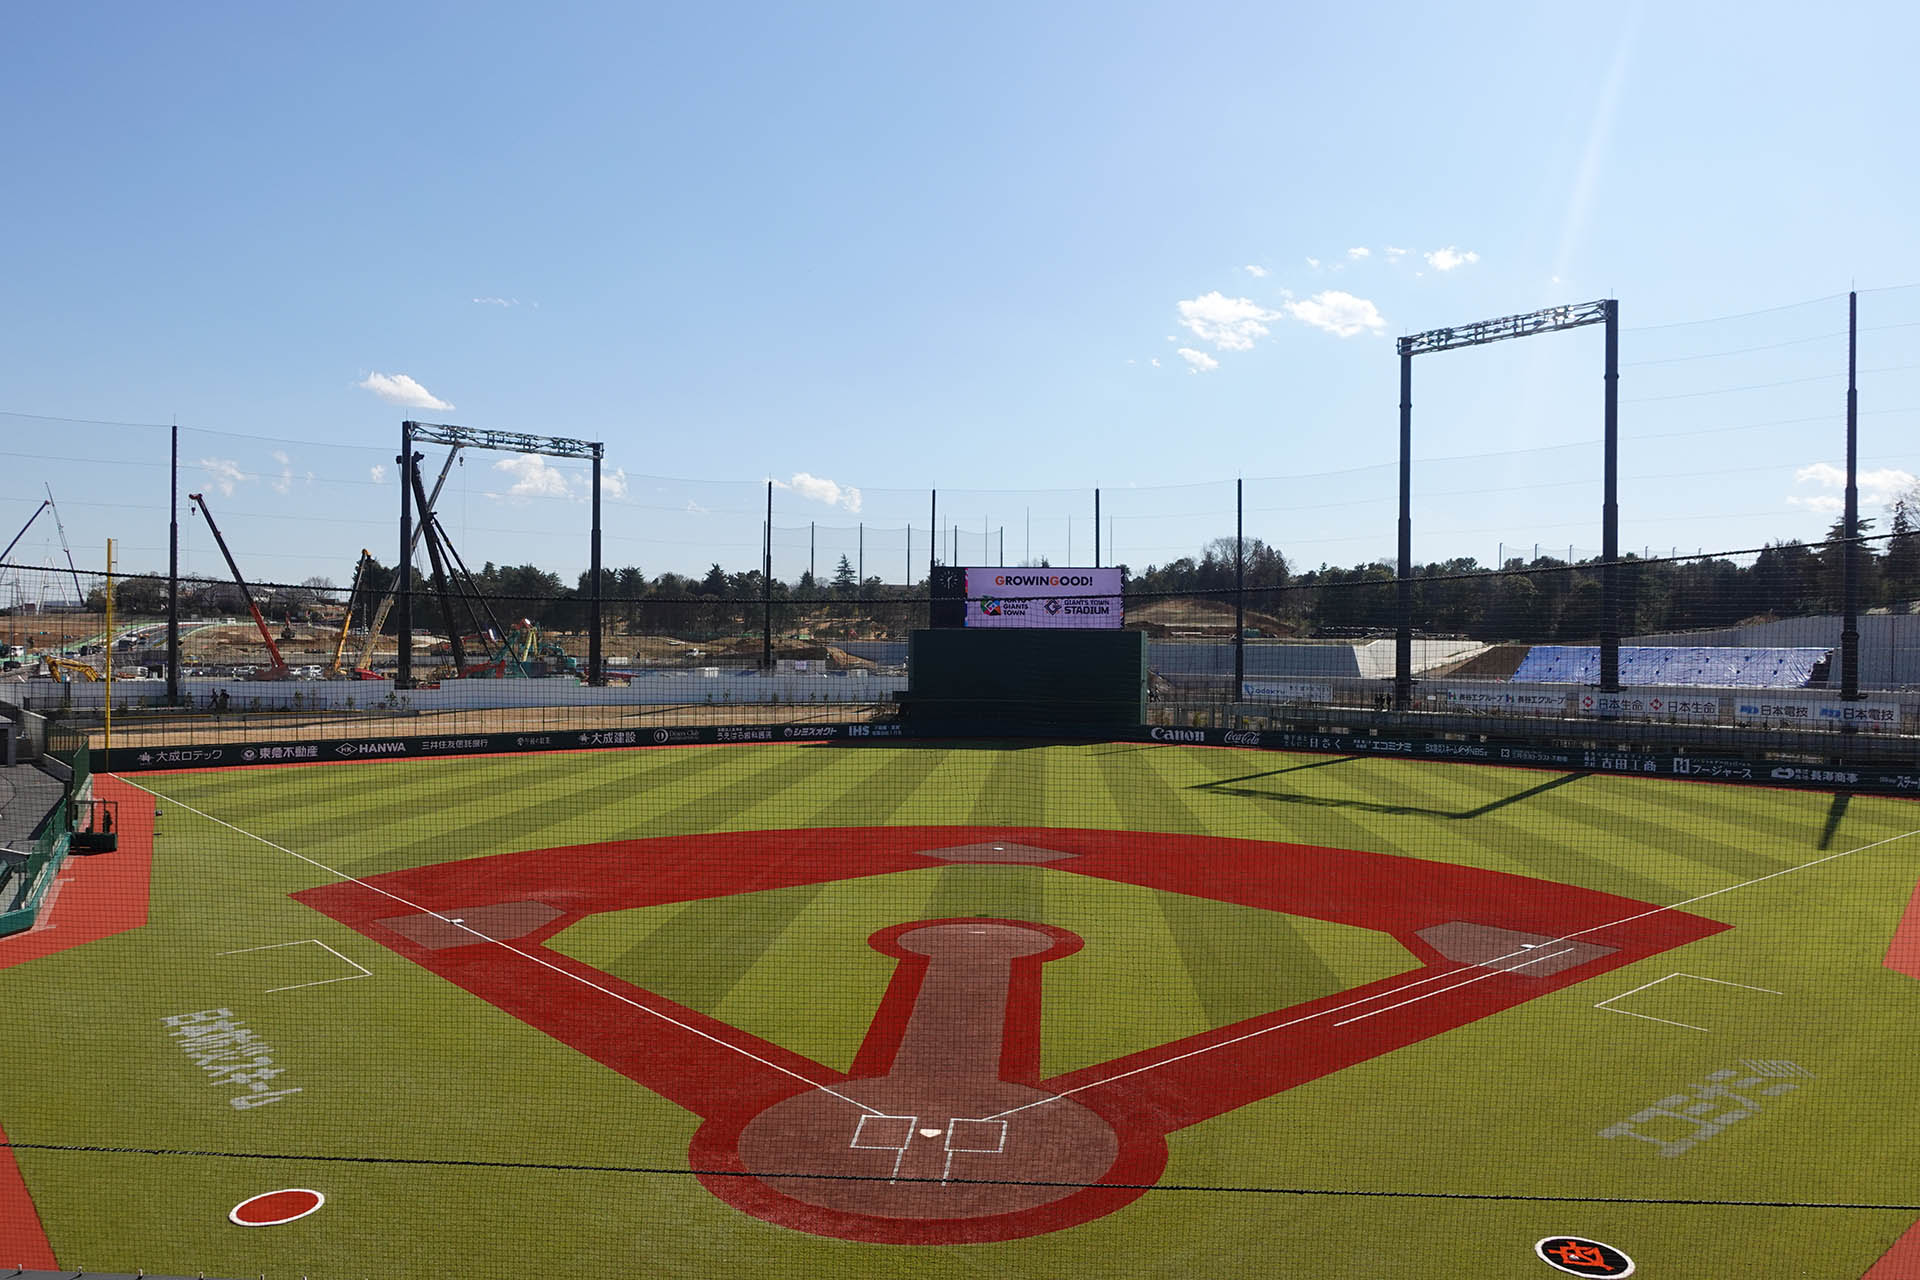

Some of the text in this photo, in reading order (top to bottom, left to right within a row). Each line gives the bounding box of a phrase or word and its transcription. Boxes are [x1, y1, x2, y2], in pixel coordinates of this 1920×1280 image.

[995, 575, 1093, 587] GROWINGOOD!
[1064, 606, 1109, 615] STADIUM
[1598, 698, 1643, 711] 日本生命
[1667, 700, 1716, 714] 日本生命
[1760, 704, 1808, 718] 日本電技
[1843, 707, 1894, 721] 日本電技
[848, 725, 870, 736] IHS
[1150, 727, 1205, 742] Canon
[591, 731, 636, 744] 大成建設
[359, 742, 406, 754] HANWA
[422, 739, 488, 750] 三井住友信託銀行
[1371, 741, 1412, 752] エコミナミ
[156, 749, 223, 762] 大成ロテック
[259, 745, 318, 759] 東急不動産
[1692, 765, 1752, 778] フージャース
